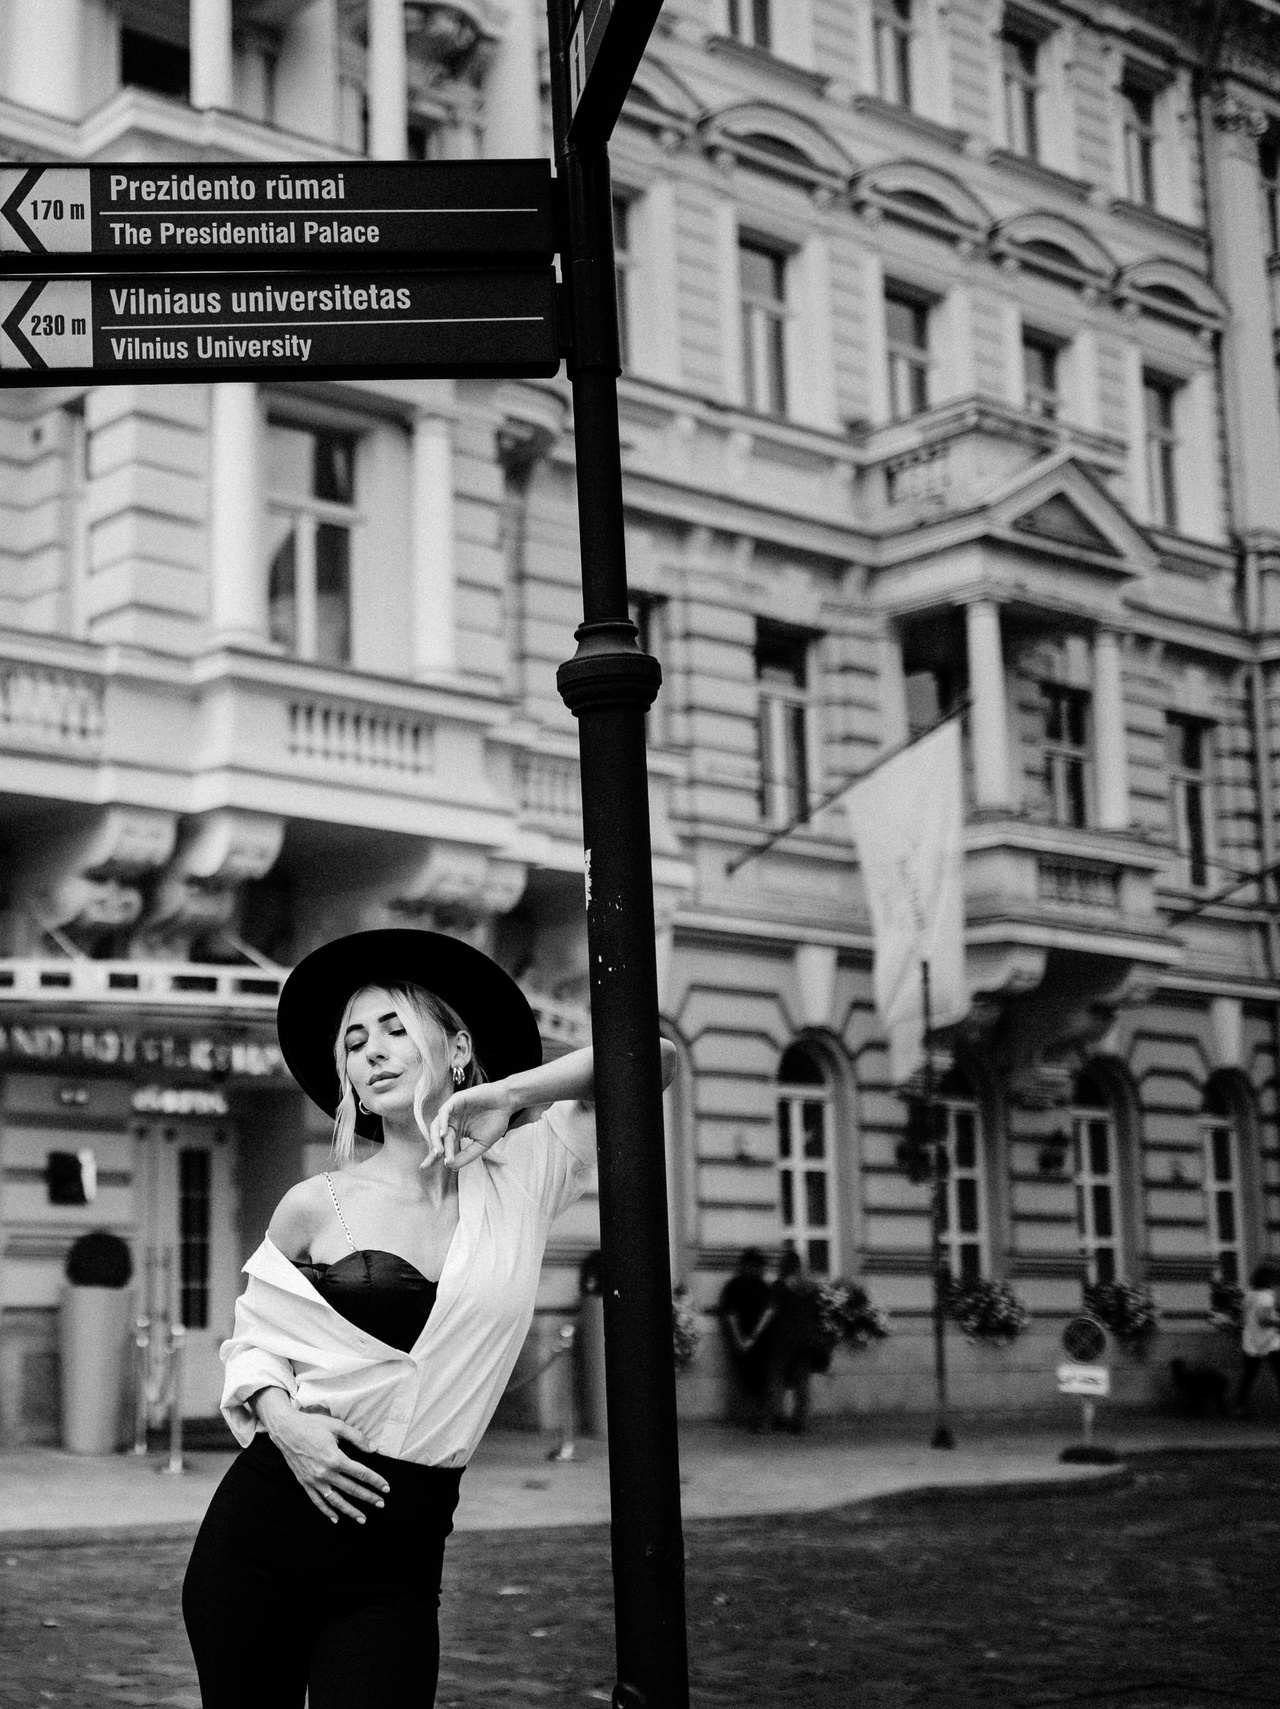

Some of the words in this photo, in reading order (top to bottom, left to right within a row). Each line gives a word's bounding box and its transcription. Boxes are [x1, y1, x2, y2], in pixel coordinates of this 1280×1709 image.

[110, 174, 256, 201] Prezidento
[266, 173, 345, 200] rūmai
[30, 200, 64, 221] 170
[70, 203, 85, 220] m
[110, 222, 152, 245] The
[160, 221, 296, 245] Presidential
[304, 221, 380, 244] Palace
[109, 287, 222, 315] Vilniaus
[231, 283, 411, 313] universitetas
[30, 314, 65, 336] 230
[71, 318, 86, 336] m
[110, 336, 189, 360] Vilnius
[196, 334, 312, 362] University
